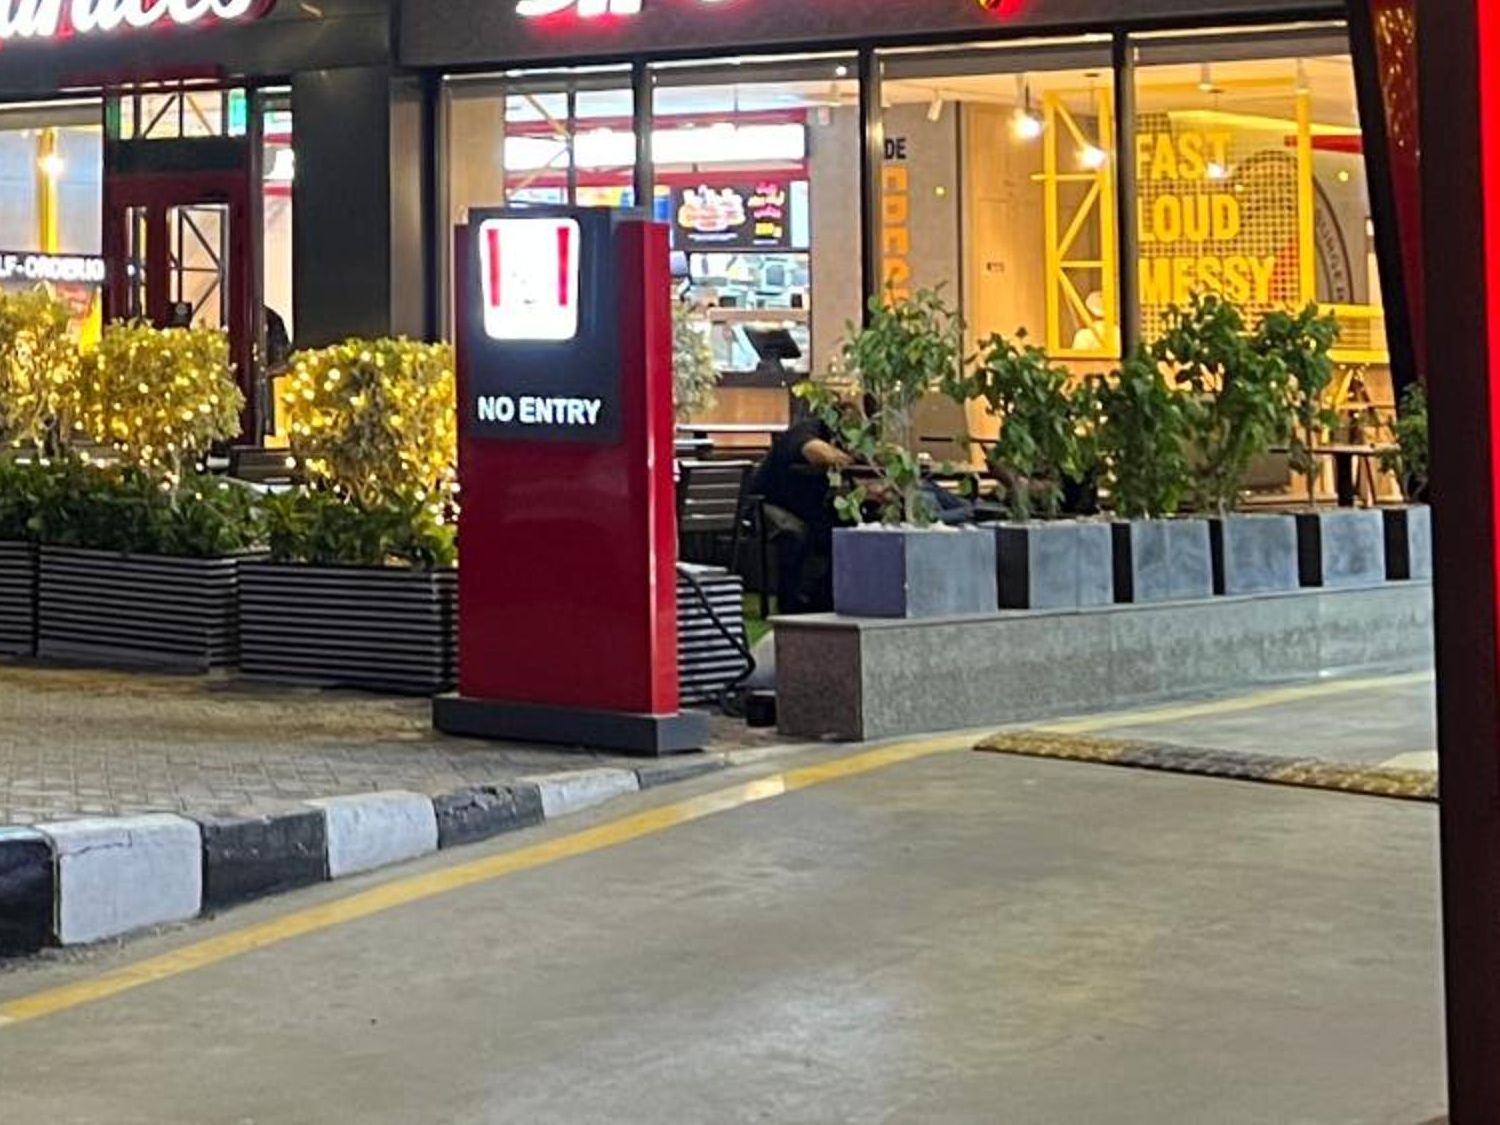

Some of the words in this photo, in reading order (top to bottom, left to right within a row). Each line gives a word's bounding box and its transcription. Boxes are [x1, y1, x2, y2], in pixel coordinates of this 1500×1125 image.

[1135, 131, 1232, 180] FAST
[1136, 193, 1242, 242] LOUD
[1137, 255, 1277, 306] MESSY
[477, 395, 515, 422] NO
[518, 395, 602, 425] ENTRY
